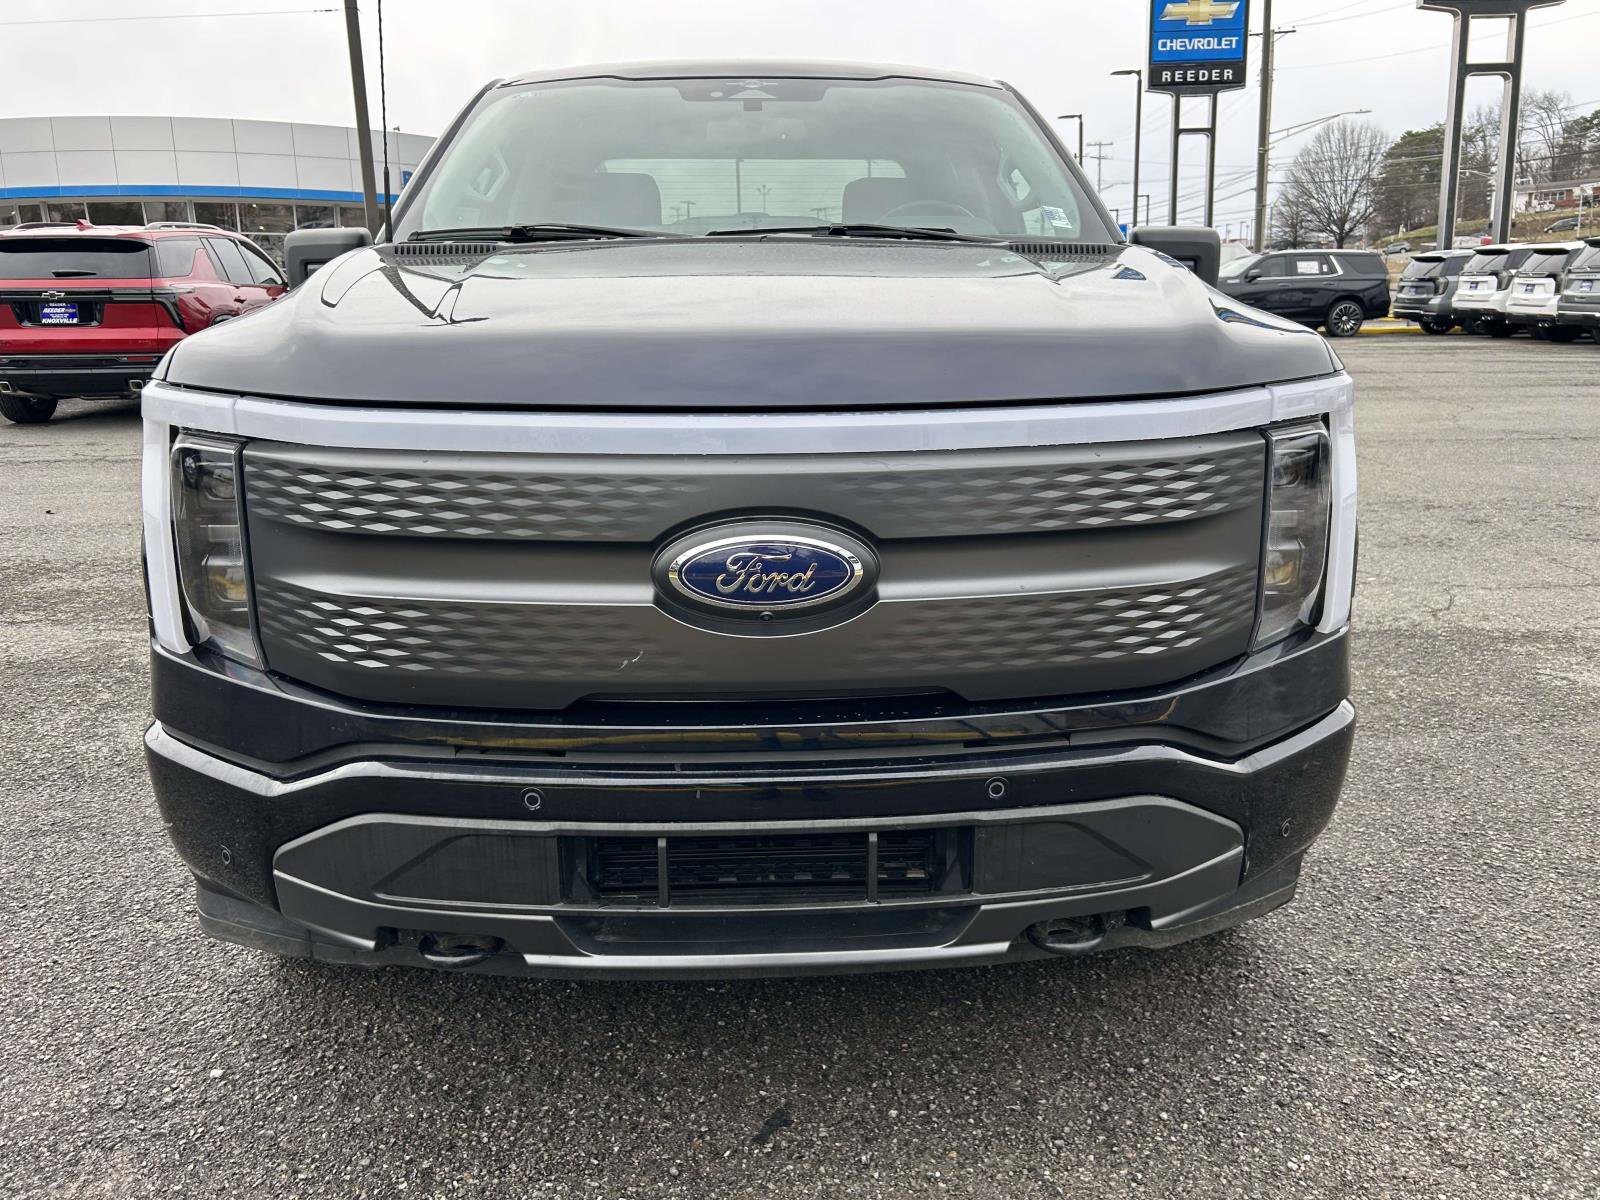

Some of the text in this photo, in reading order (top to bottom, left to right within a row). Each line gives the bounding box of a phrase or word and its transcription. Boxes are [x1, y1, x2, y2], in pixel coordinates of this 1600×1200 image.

[1157, 37, 1239, 51] CHEVROLET
[1161, 69, 1233, 82] REEDER
[715, 552, 818, 593] Ford
